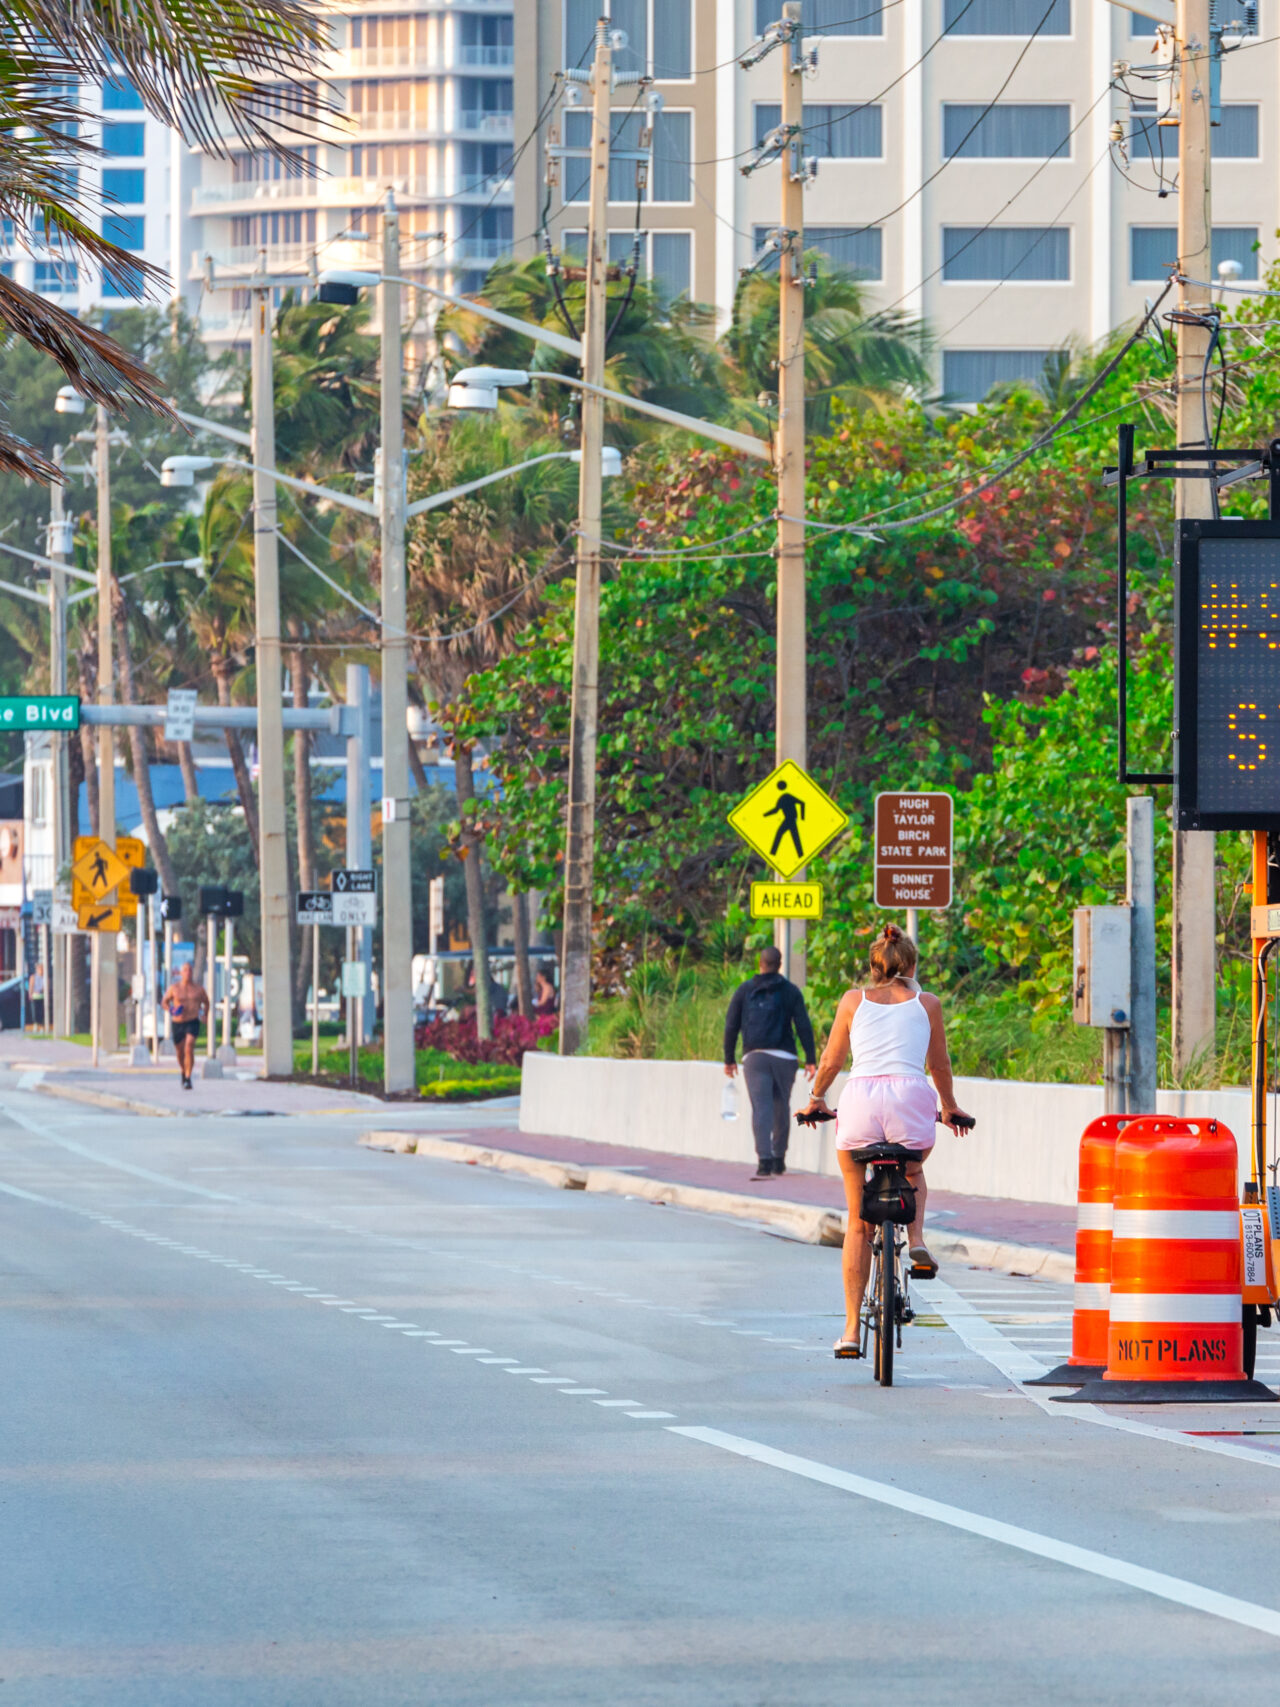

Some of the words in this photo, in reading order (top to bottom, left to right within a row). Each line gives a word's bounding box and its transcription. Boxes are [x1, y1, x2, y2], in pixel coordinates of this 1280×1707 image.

[0, 708, 14, 722] e
[26, 704, 73, 722] Blvd
[899, 799, 929, 809] HUGH
[893, 814, 935, 825] TAYLOR
[898, 830, 930, 841] BIRCH
[881, 846, 912, 857] STATE
[918, 846, 947, 857] PARK
[892, 874, 934, 885] BONNET
[761, 892, 813, 908] AHEAD
[895, 889, 931, 900] HOUSE
[340, 912, 367, 921] ONLY
[1253, 1225, 1264, 1258] PLANS
[1245, 1225, 1256, 1282] 813-600-7884
[1118, 1339, 1153, 1361] MOT
[1158, 1339, 1226, 1362] PLANS
